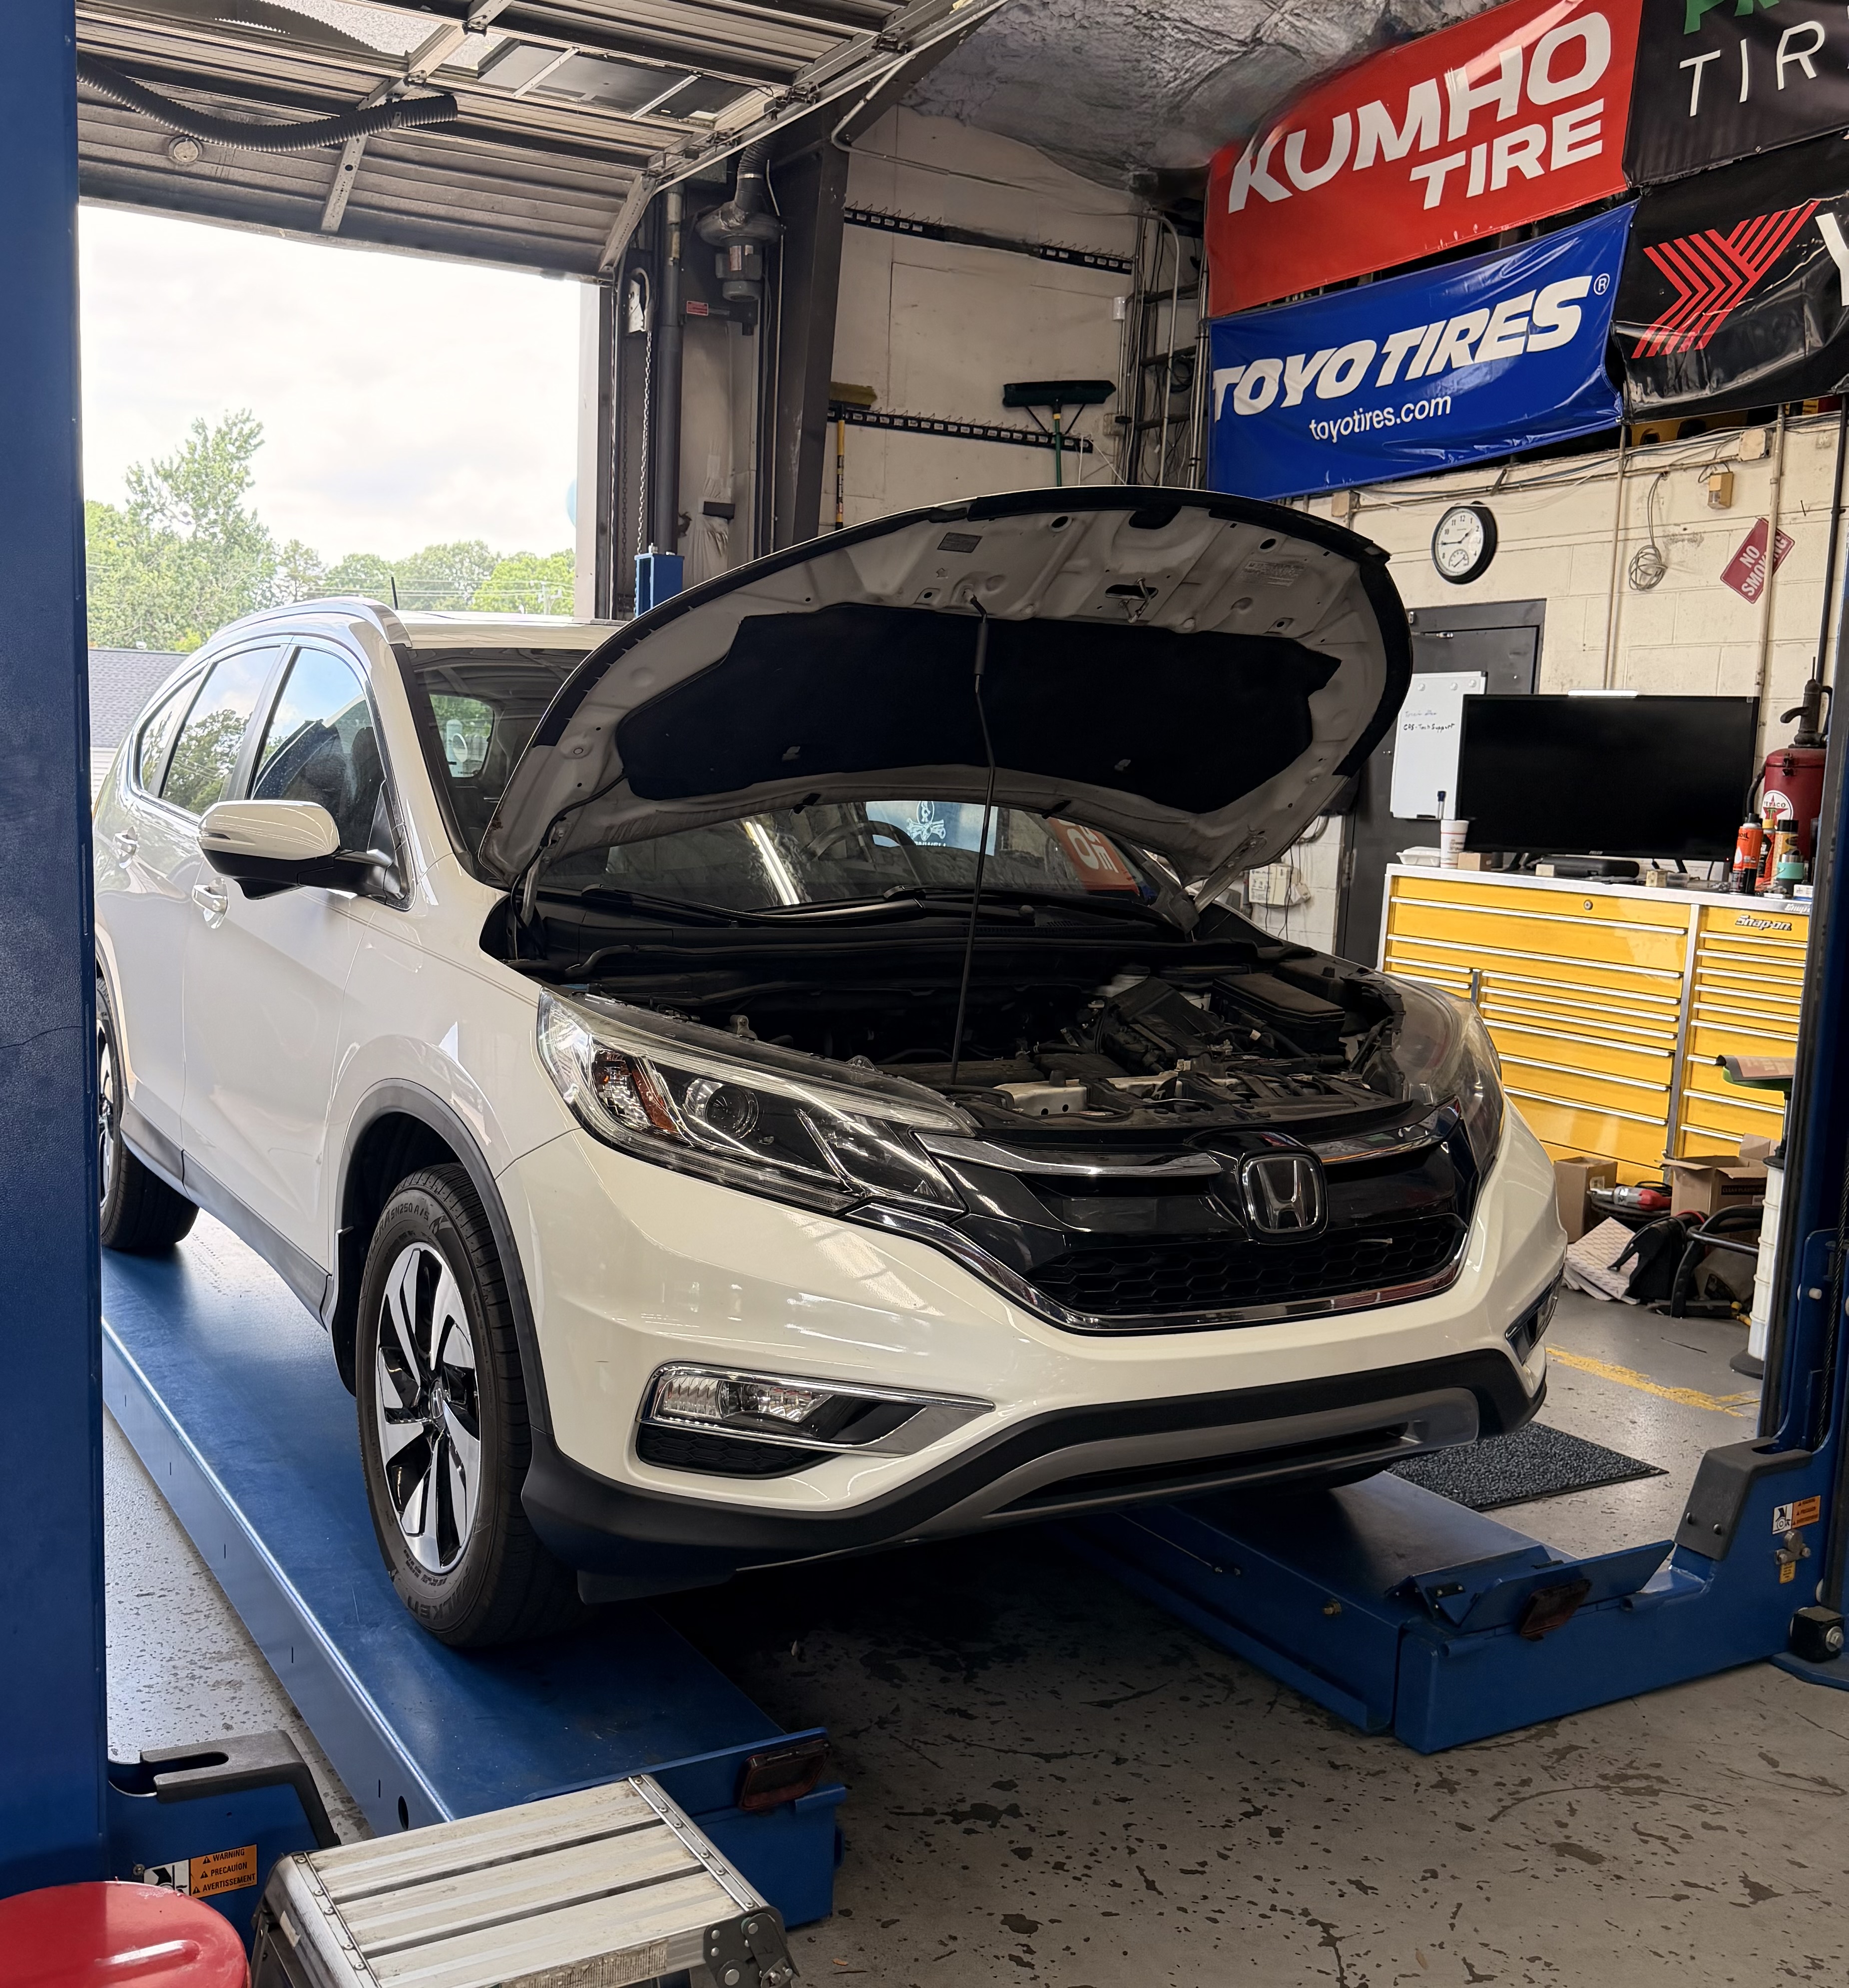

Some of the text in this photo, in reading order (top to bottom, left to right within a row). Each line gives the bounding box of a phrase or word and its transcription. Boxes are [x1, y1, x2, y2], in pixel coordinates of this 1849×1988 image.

[1679, 5, 1849, 117] TIR
[1228, 11, 1611, 214] KUMHO
[1409, 98, 1604, 210] TIRE
[1212, 339, 1378, 423] TOYO
[1376, 276, 1592, 388] TIRES
[1309, 395, 1452, 443] toyotires.com
[1739, 545, 1760, 568] NO
[1735, 915, 1792, 931] Snap-on
[391, 1202, 413, 1220] SN250
[213, 1848, 245, 1862] WARNING
[203, 1873, 255, 1892] AVERTISSEMENT
